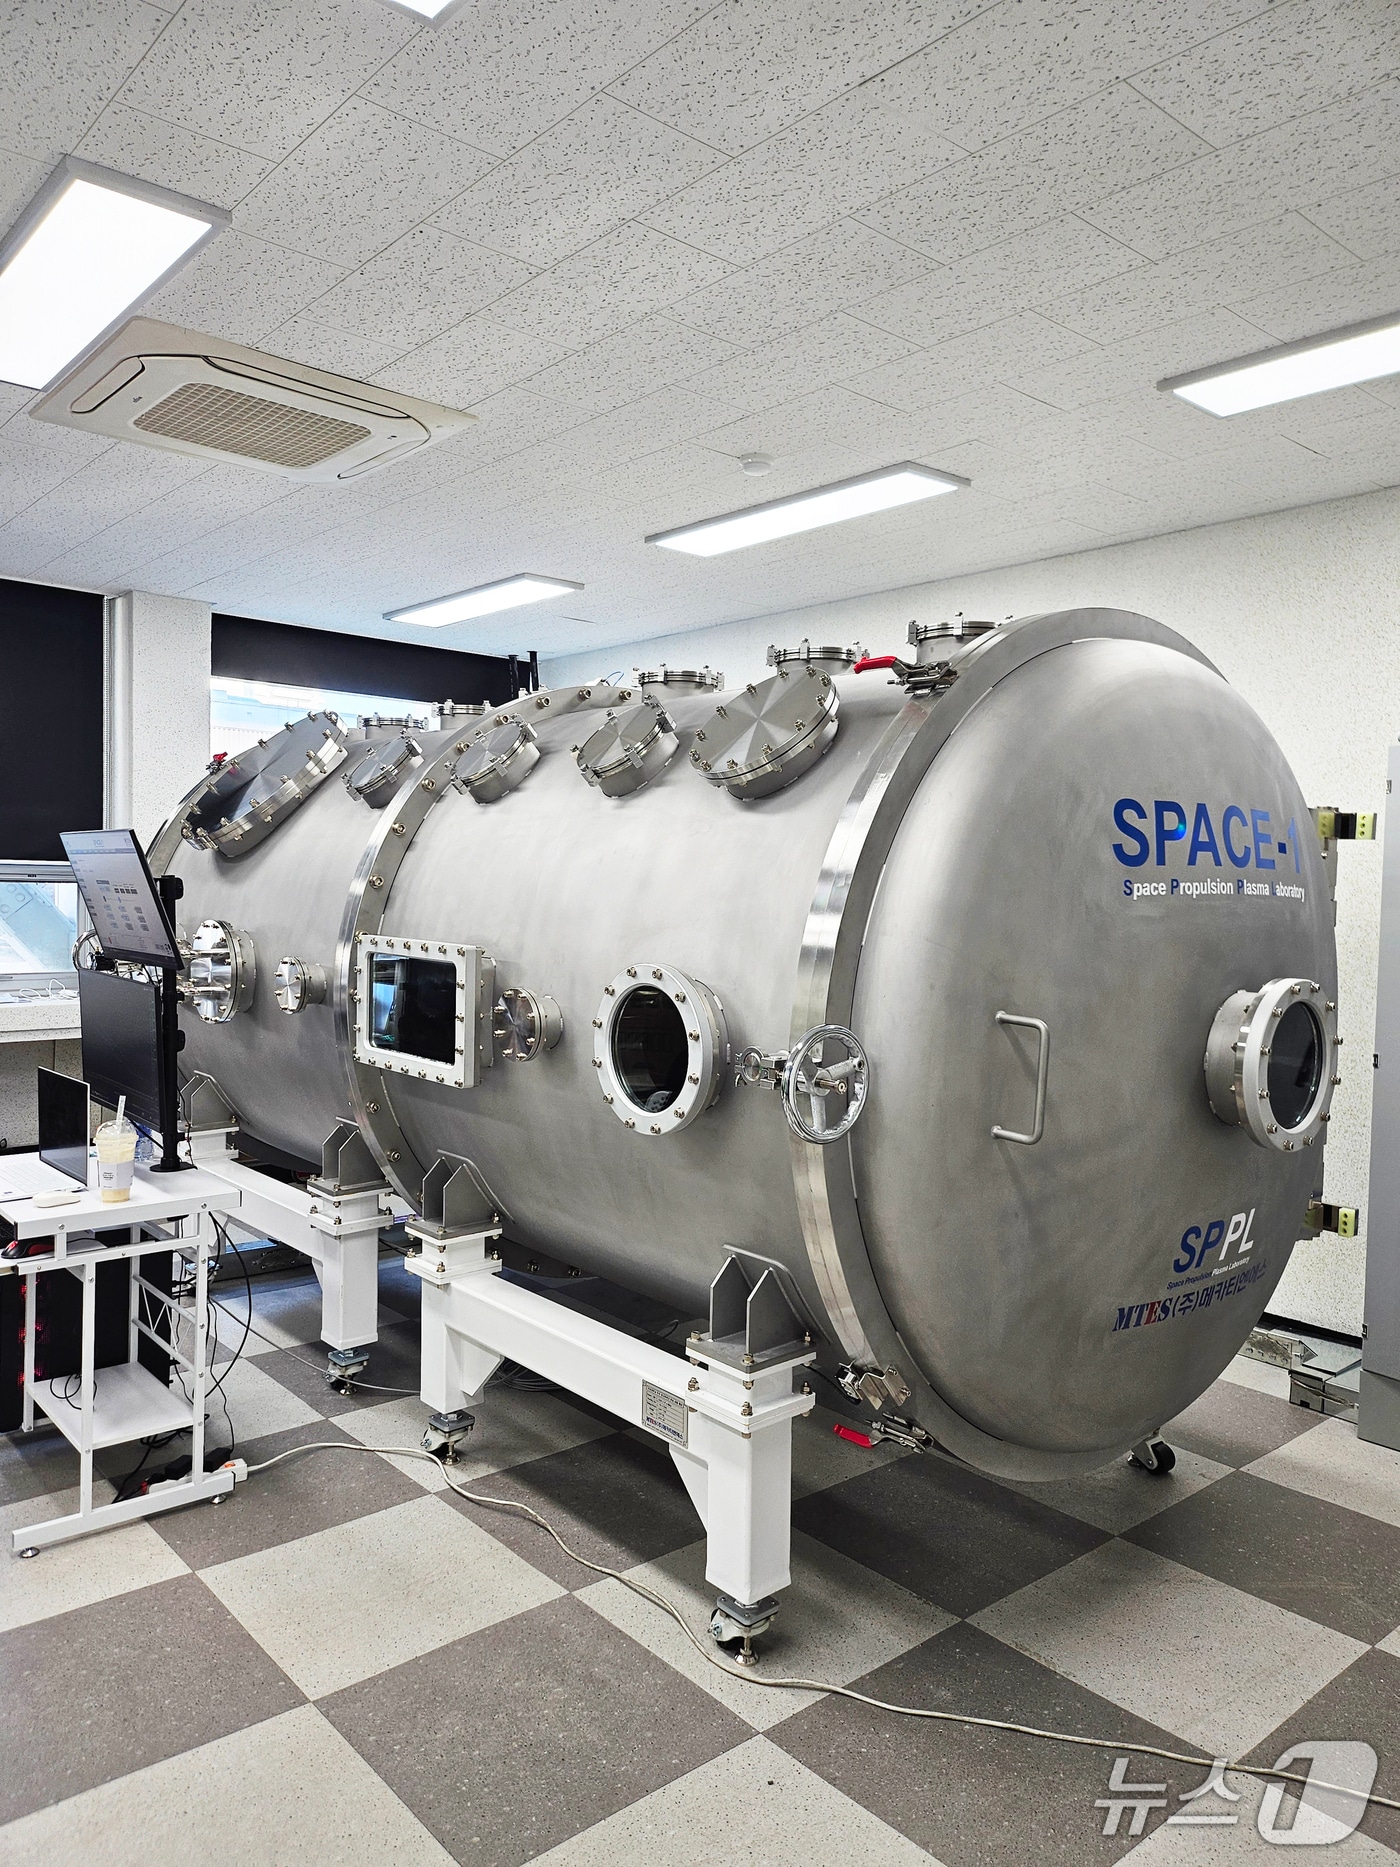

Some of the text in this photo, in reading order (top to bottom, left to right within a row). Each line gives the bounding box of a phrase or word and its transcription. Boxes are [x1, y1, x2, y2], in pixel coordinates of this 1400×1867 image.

[1112, 798, 1301, 874] SPACE-1
[1123, 879, 1167, 900] Space
[1170, 878, 1234, 898] Propulsion
[1237, 879, 1270, 896] Plasma
[1173, 1208, 1256, 1274] SPPL
[1167, 1280, 1185, 1291] Space
